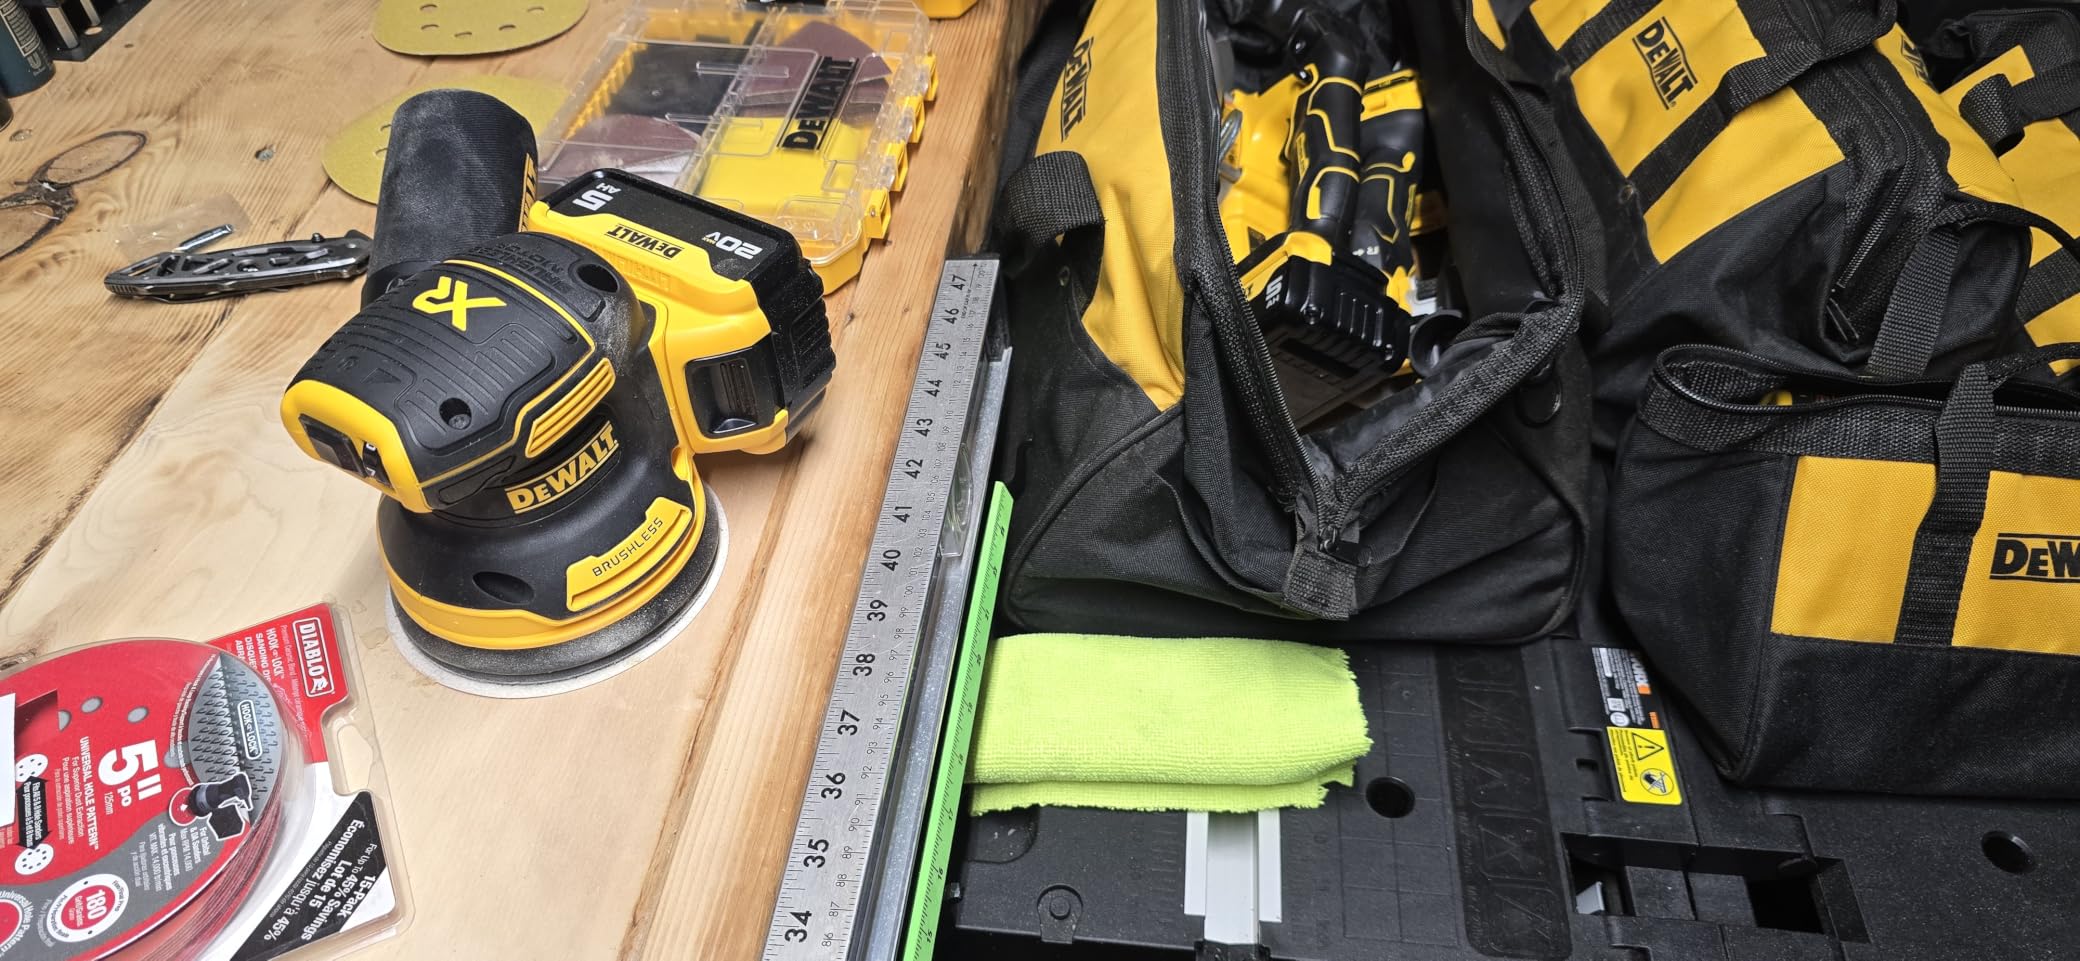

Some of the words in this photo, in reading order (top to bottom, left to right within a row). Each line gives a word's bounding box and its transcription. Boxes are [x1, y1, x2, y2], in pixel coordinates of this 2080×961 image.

[1632, 16, 1698, 110] DEWALT
[777, 56, 860, 150] DEWALT
[596, 182, 622, 194] AH
[572, 189, 614, 211] 5
[604, 223, 685, 261] DEWALT
[950, 275, 966, 289] 47
[412, 276, 507, 332] XR
[942, 307, 959, 323] 46
[933, 341, 951, 359] 45
[924, 378, 942, 395] 44
[913, 416, 933, 435] 43
[506, 422, 619, 514] DEWALT
[903, 457, 923, 478] 42
[891, 504, 912, 521] 41
[592, 516, 663, 578] BRUSHLESS
[880, 548, 901, 570] 40
[866, 600, 888, 621] 39
[899, 607, 908, 617] 99
[894, 628, 904, 638] 98
[255, 632, 268, 668] SANDING
[298, 621, 324, 677] DIABLO
[889, 650, 898, 659] 97
[852, 653, 876, 676] 38
[883, 671, 894, 682] 96
[878, 694, 888, 705] 95
[836, 712, 861, 735] 37
[872, 717, 882, 728] 94
[866, 742, 877, 754] 93
[79, 736, 92, 782] UNIVERSAL
[860, 766, 872, 778] 92
[84, 782, 94, 805] HOLE
[117, 785, 132, 807] po
[820, 772, 846, 799] 36
[64, 783, 72, 812] aspiration
[72, 768, 80, 791] Superior
[76, 806, 84, 837] Extraction
[104, 791, 113, 814] 125mm
[854, 793, 864, 805] 91
[34, 819, 42, 840] Sanders
[848, 818, 860, 831] 90
[312, 819, 365, 881] Économisez
[357, 854, 371, 865] Up
[365, 843, 378, 855] For
[802, 839, 830, 867] 35
[842, 846, 852, 858] 89
[334, 860, 352, 879] Lot
[351, 865, 363, 874] To
[835, 873, 847, 886] 88
[320, 879, 337, 893] de
[334, 874, 359, 899] 45%
[337, 875, 377, 918] 15-Pack
[85, 889, 107, 919] 180
[309, 893, 327, 908] 15
[828, 903, 840, 916] 87
[263, 914, 290, 941] 45%
[301, 898, 341, 941] Savings
[783, 909, 812, 942] 34
[821, 932, 834, 946] 86
